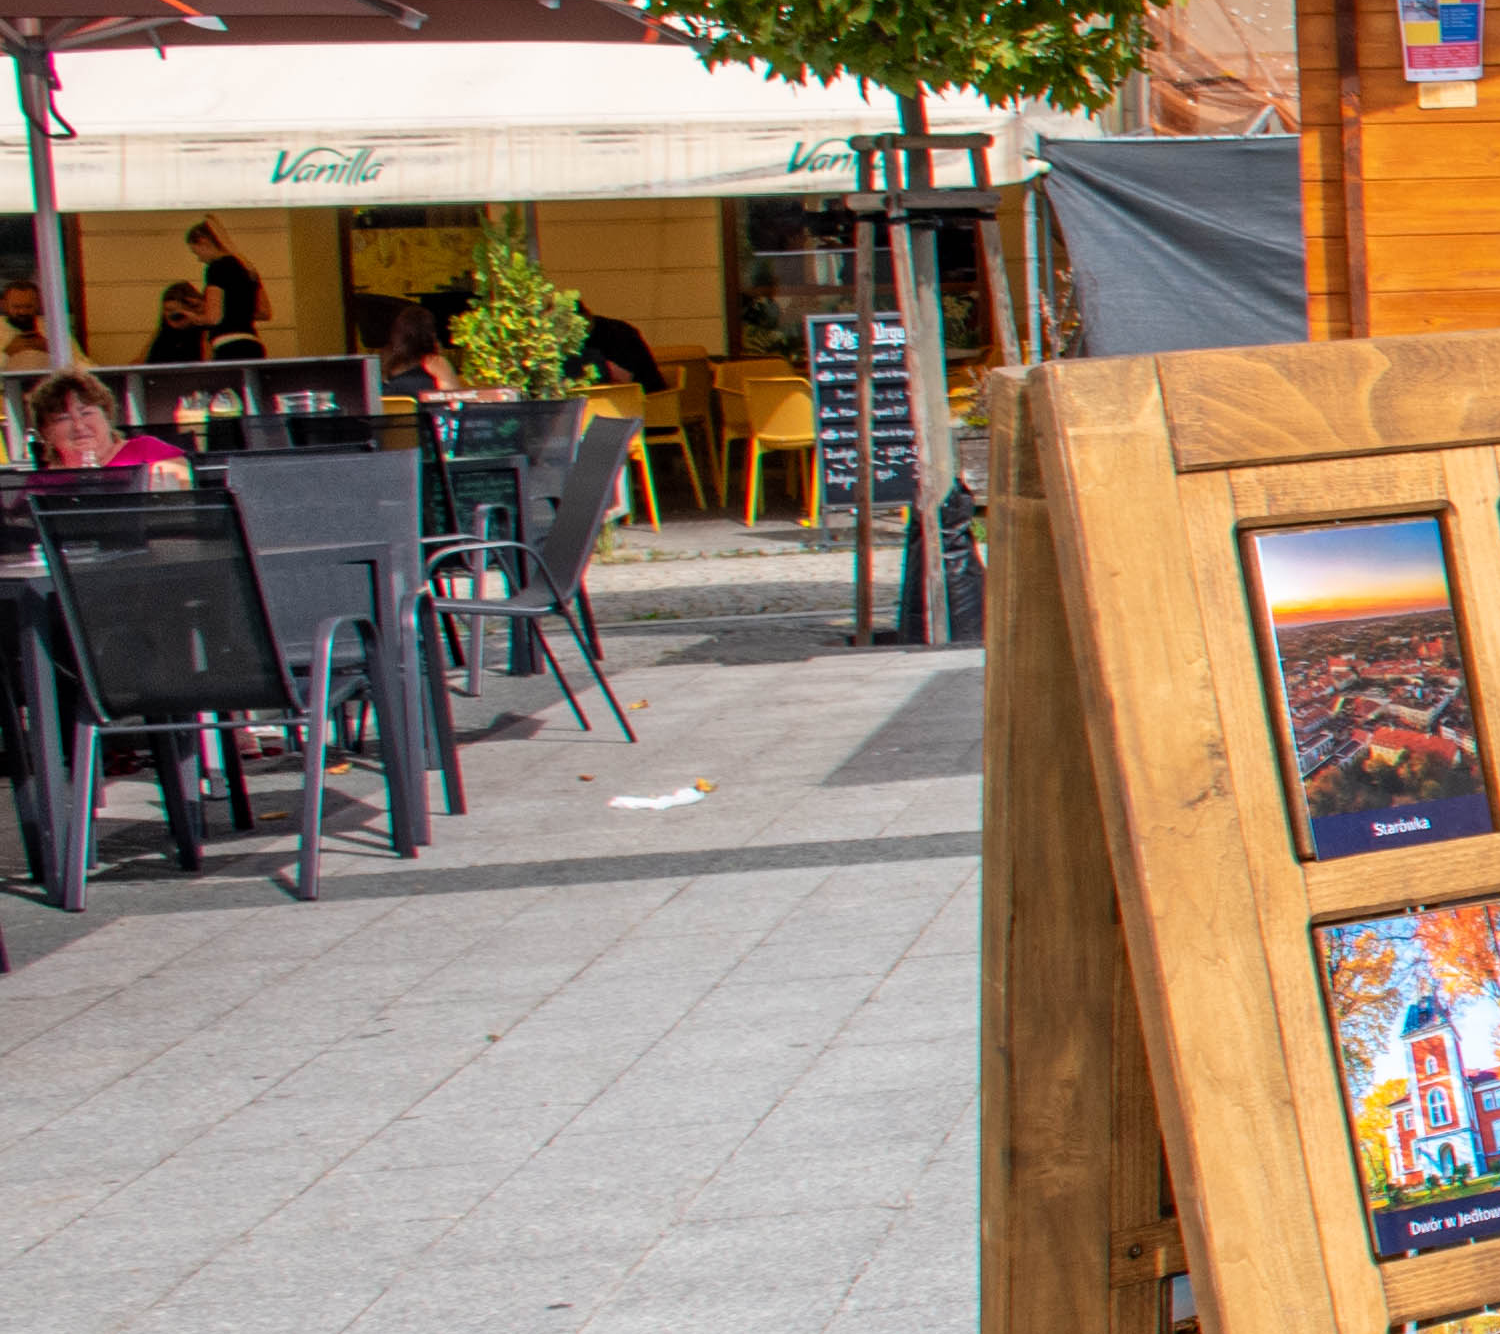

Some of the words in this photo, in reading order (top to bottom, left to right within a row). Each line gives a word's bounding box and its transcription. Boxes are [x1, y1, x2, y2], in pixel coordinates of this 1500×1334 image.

[268, 146, 385, 185] Vanilla
[1374, 815, 1432, 837] Starówka
[1409, 1216, 1443, 1236] Dwór
[1443, 1217, 1458, 1229] w
